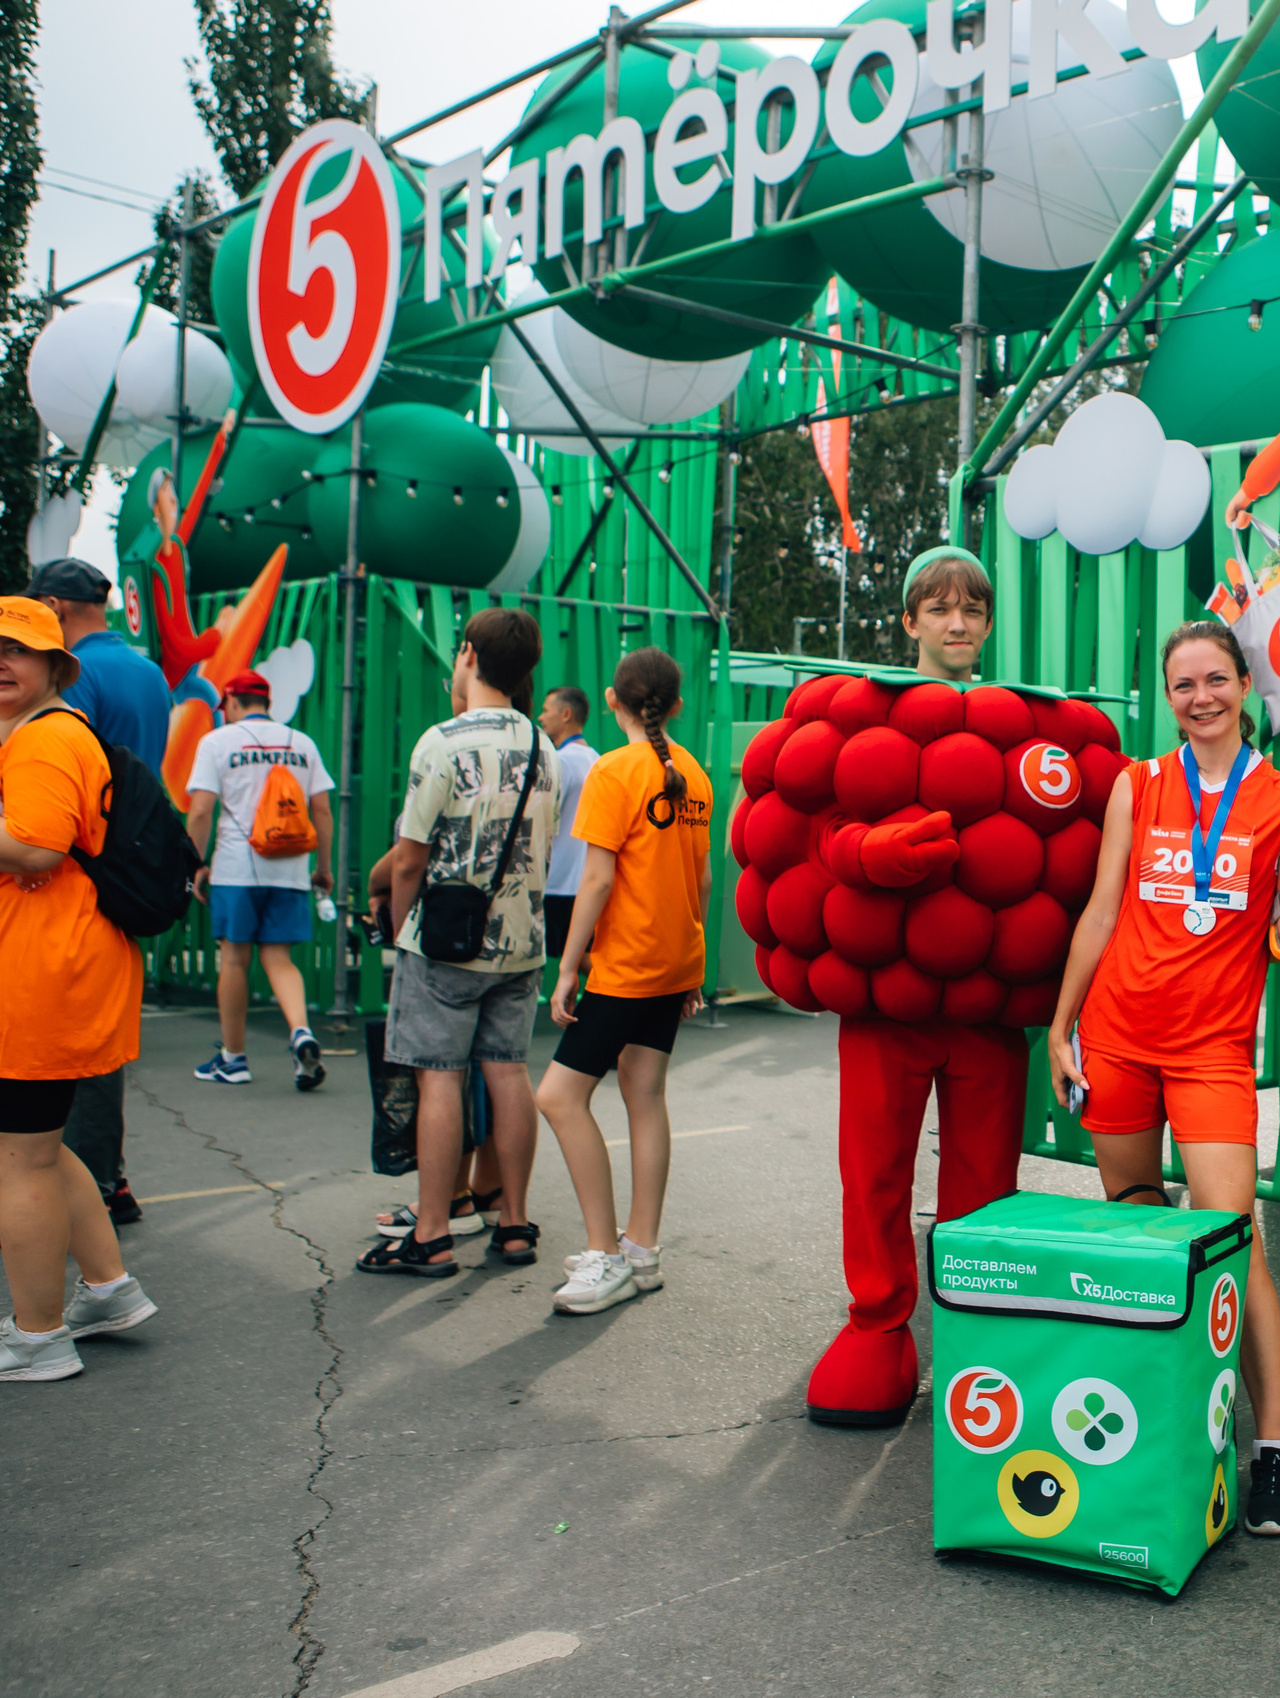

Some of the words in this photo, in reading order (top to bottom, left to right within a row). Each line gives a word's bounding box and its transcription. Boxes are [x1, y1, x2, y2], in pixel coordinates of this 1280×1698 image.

[229, 750, 308, 769] CHAMPION
[1153, 847, 1237, 879] 200
[942, 1255, 1037, 1275] Доставляем
[942, 1273, 1018, 1290] продукты
[1104, 1549, 1145, 1563] 25600
